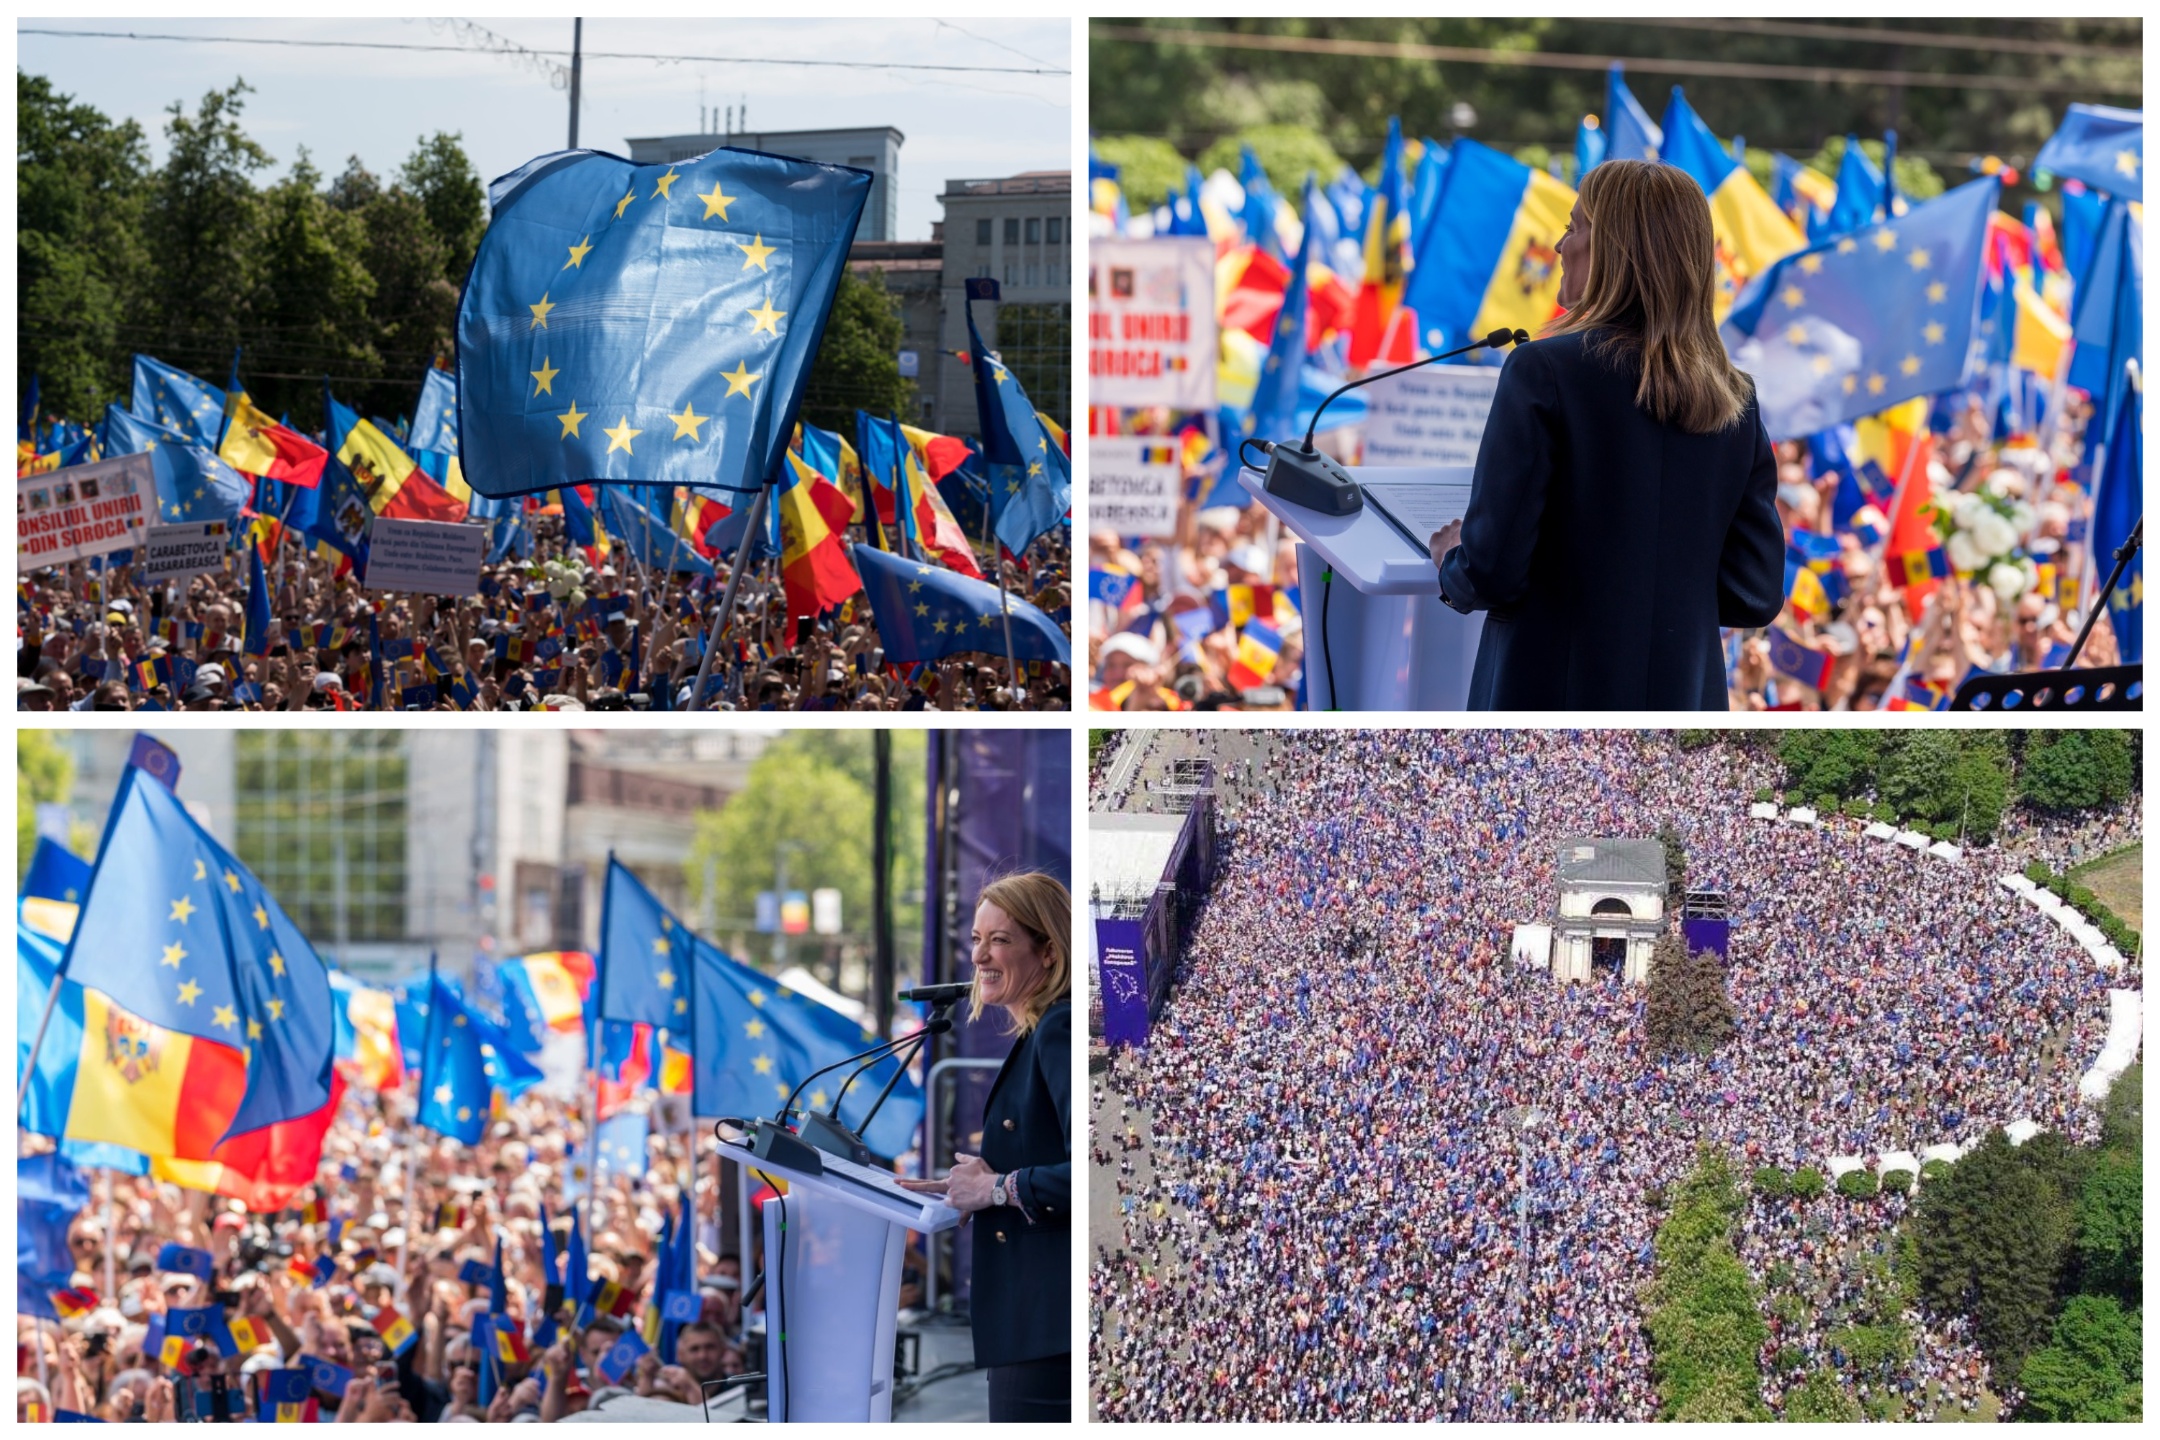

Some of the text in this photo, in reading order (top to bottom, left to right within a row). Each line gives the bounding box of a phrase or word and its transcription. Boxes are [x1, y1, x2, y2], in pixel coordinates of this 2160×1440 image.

[1089, 350, 1160, 377] OROCA
[92, 494, 142, 520] UNIRII
[29, 518, 127, 555] DIN SOROCA
[150, 541, 219, 559] CARABETOVCA
[147, 555, 222, 574] BASARABEASCA
